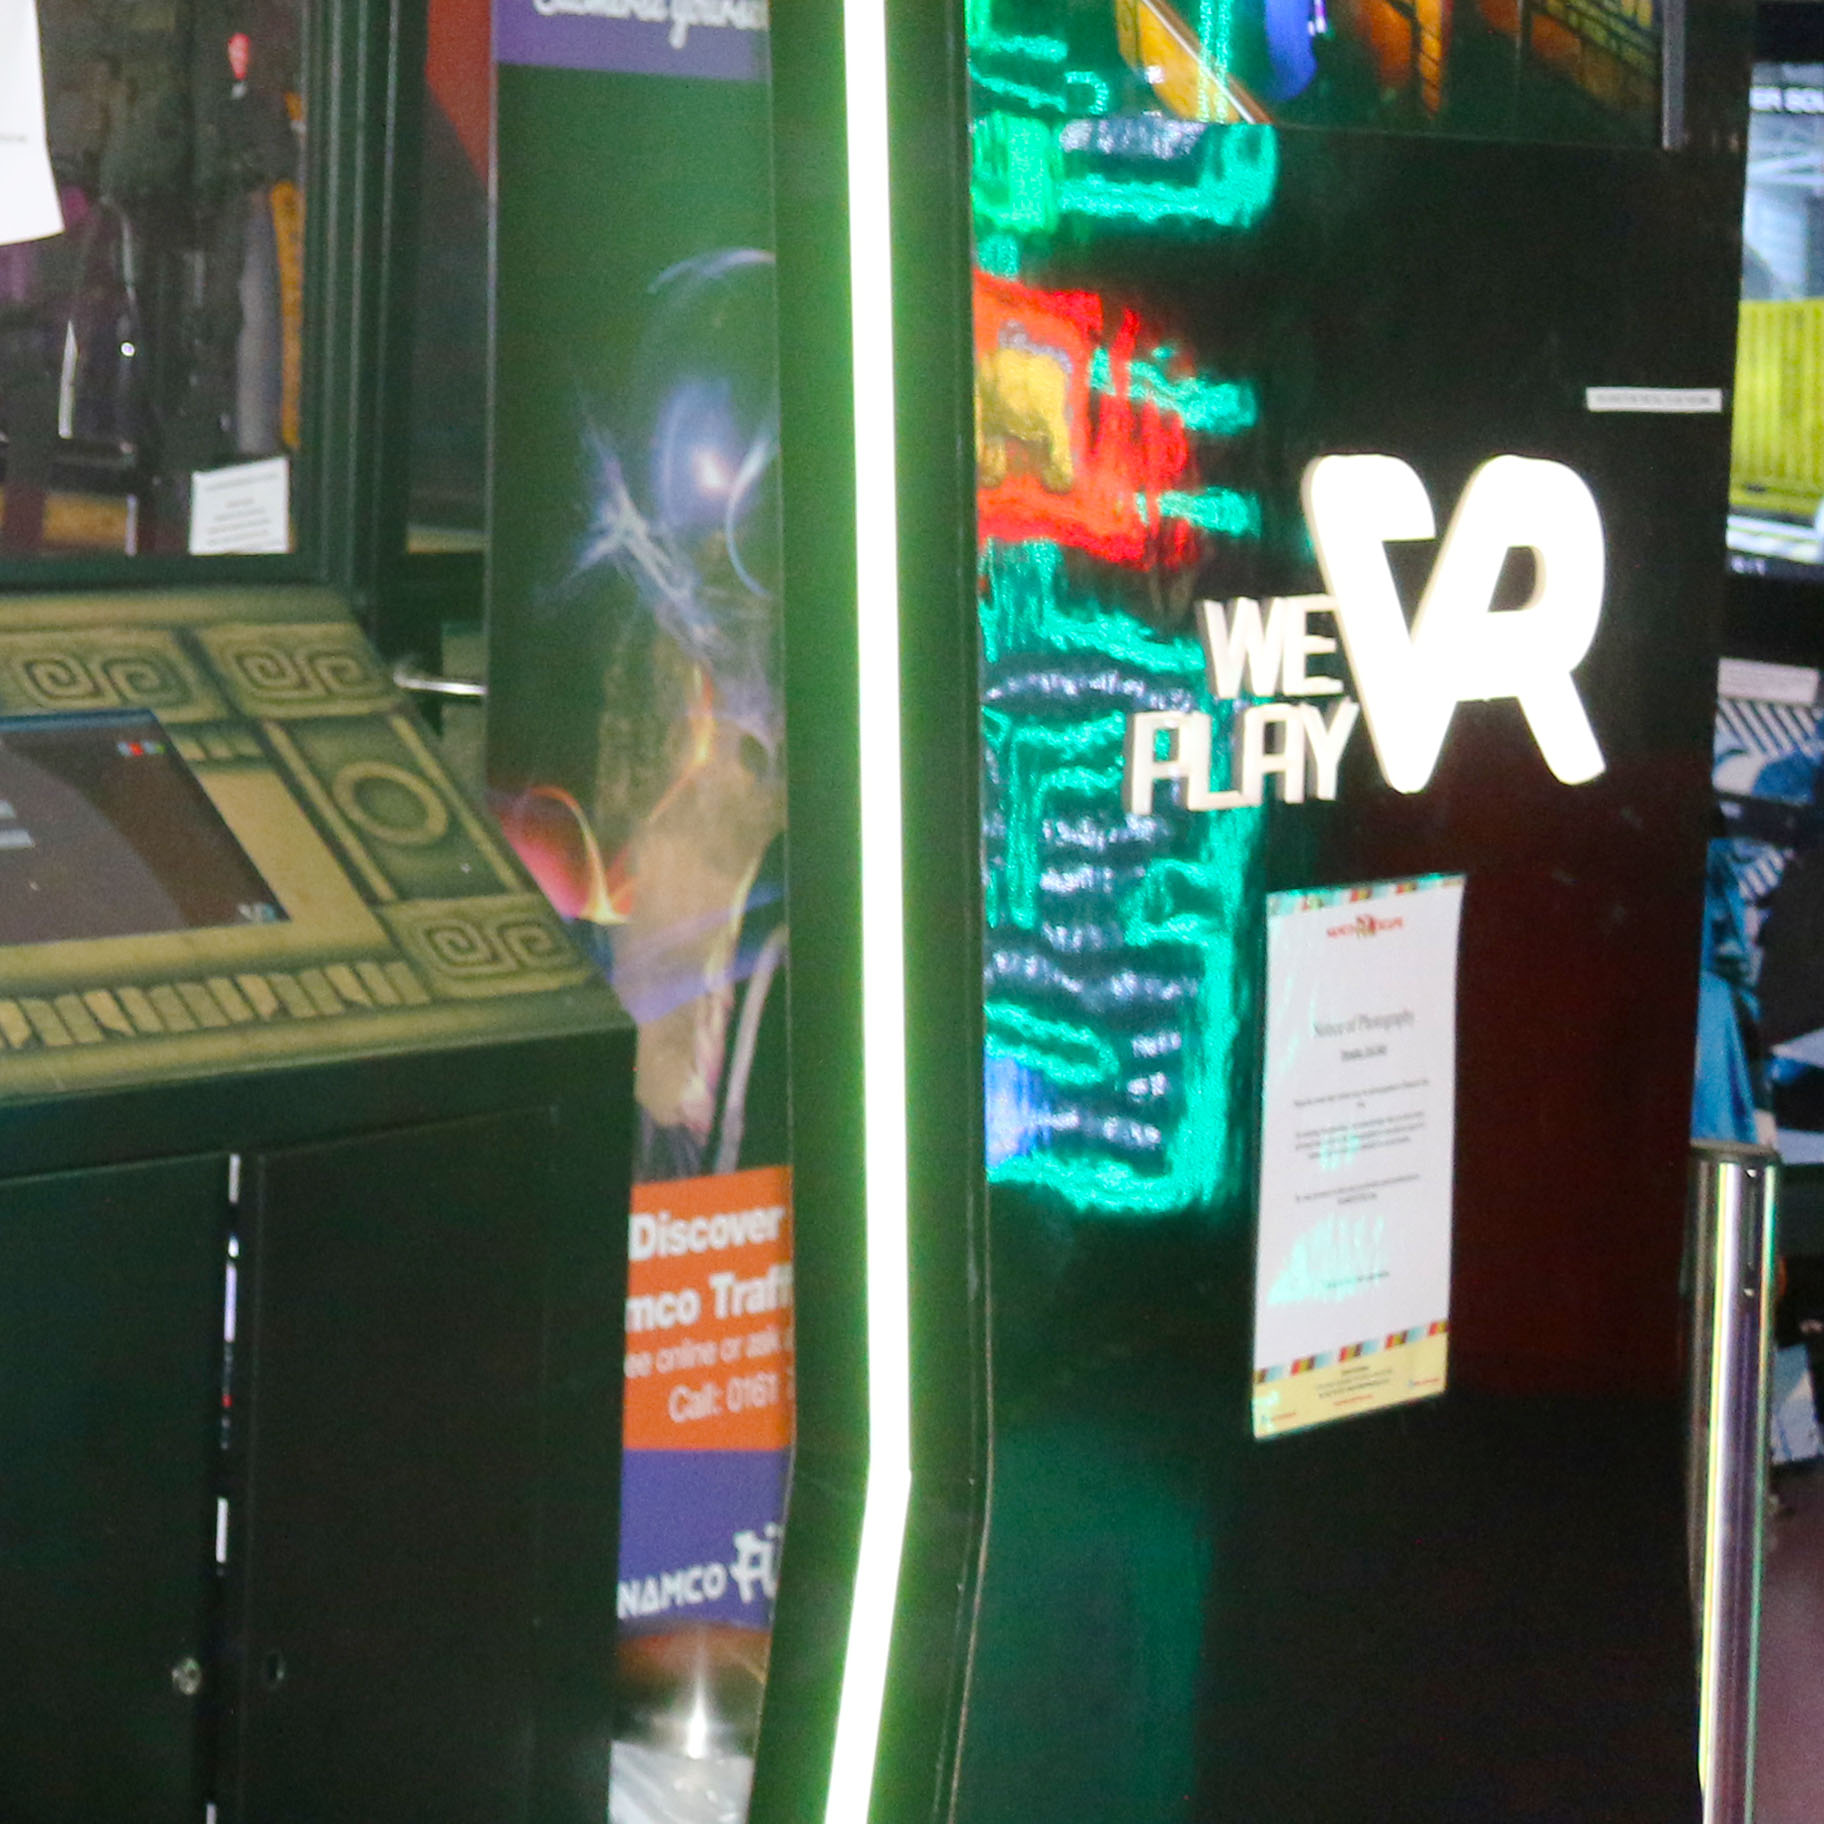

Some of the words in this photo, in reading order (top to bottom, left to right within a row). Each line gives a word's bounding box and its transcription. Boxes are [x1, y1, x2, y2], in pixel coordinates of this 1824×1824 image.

[1198, 593, 1345, 700] WE
[1301, 453, 1607, 794] VR
[1123, 698, 1359, 816] PLAY
[628, 1206, 786, 1261] Discover
[616, 1562, 728, 1620] NAMCO
